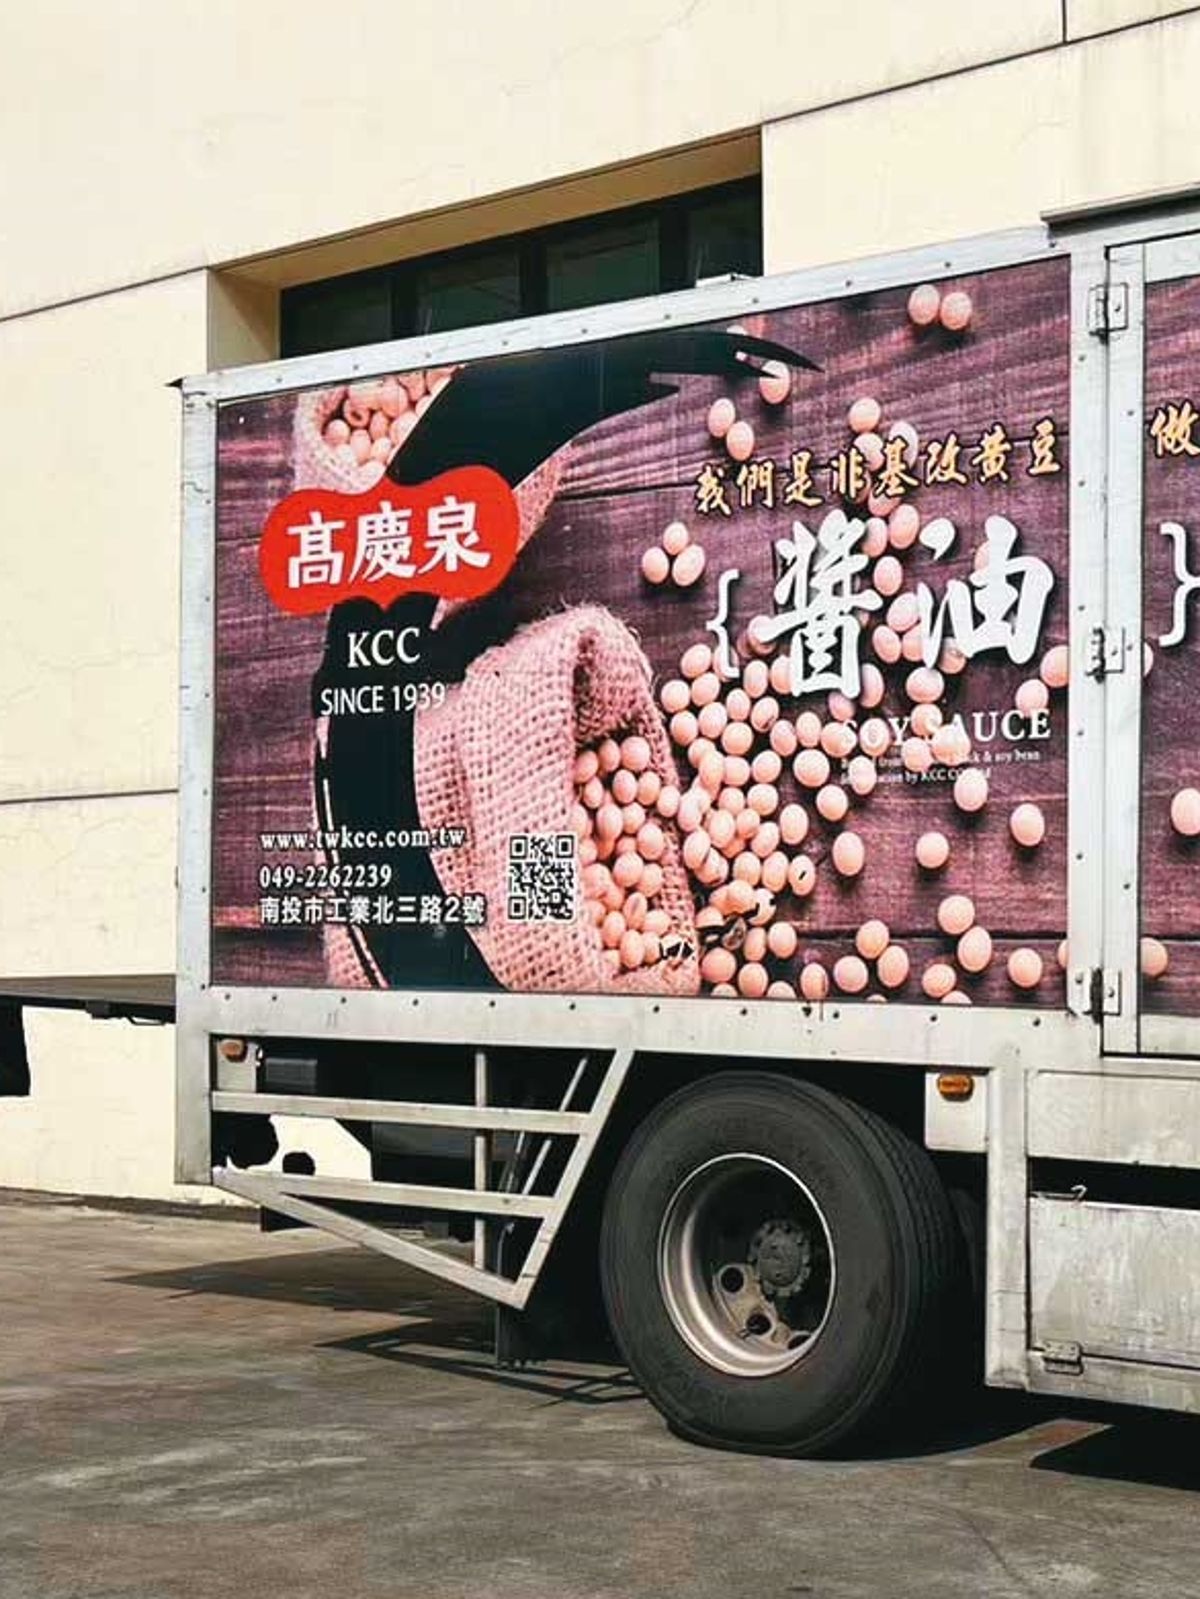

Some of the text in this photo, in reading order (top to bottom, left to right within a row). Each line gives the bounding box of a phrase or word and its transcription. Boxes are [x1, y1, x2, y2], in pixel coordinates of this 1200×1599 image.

[755, 510, 1054, 699] 醬油
[346, 627, 422, 668] KCC
[320, 682, 447, 717] SINCE 1939
[260, 827, 466, 851] www.twkcc.com.tw
[260, 864, 392, 890] 049-2262239
[260, 893, 487, 925] 南投市工業北三路2號
